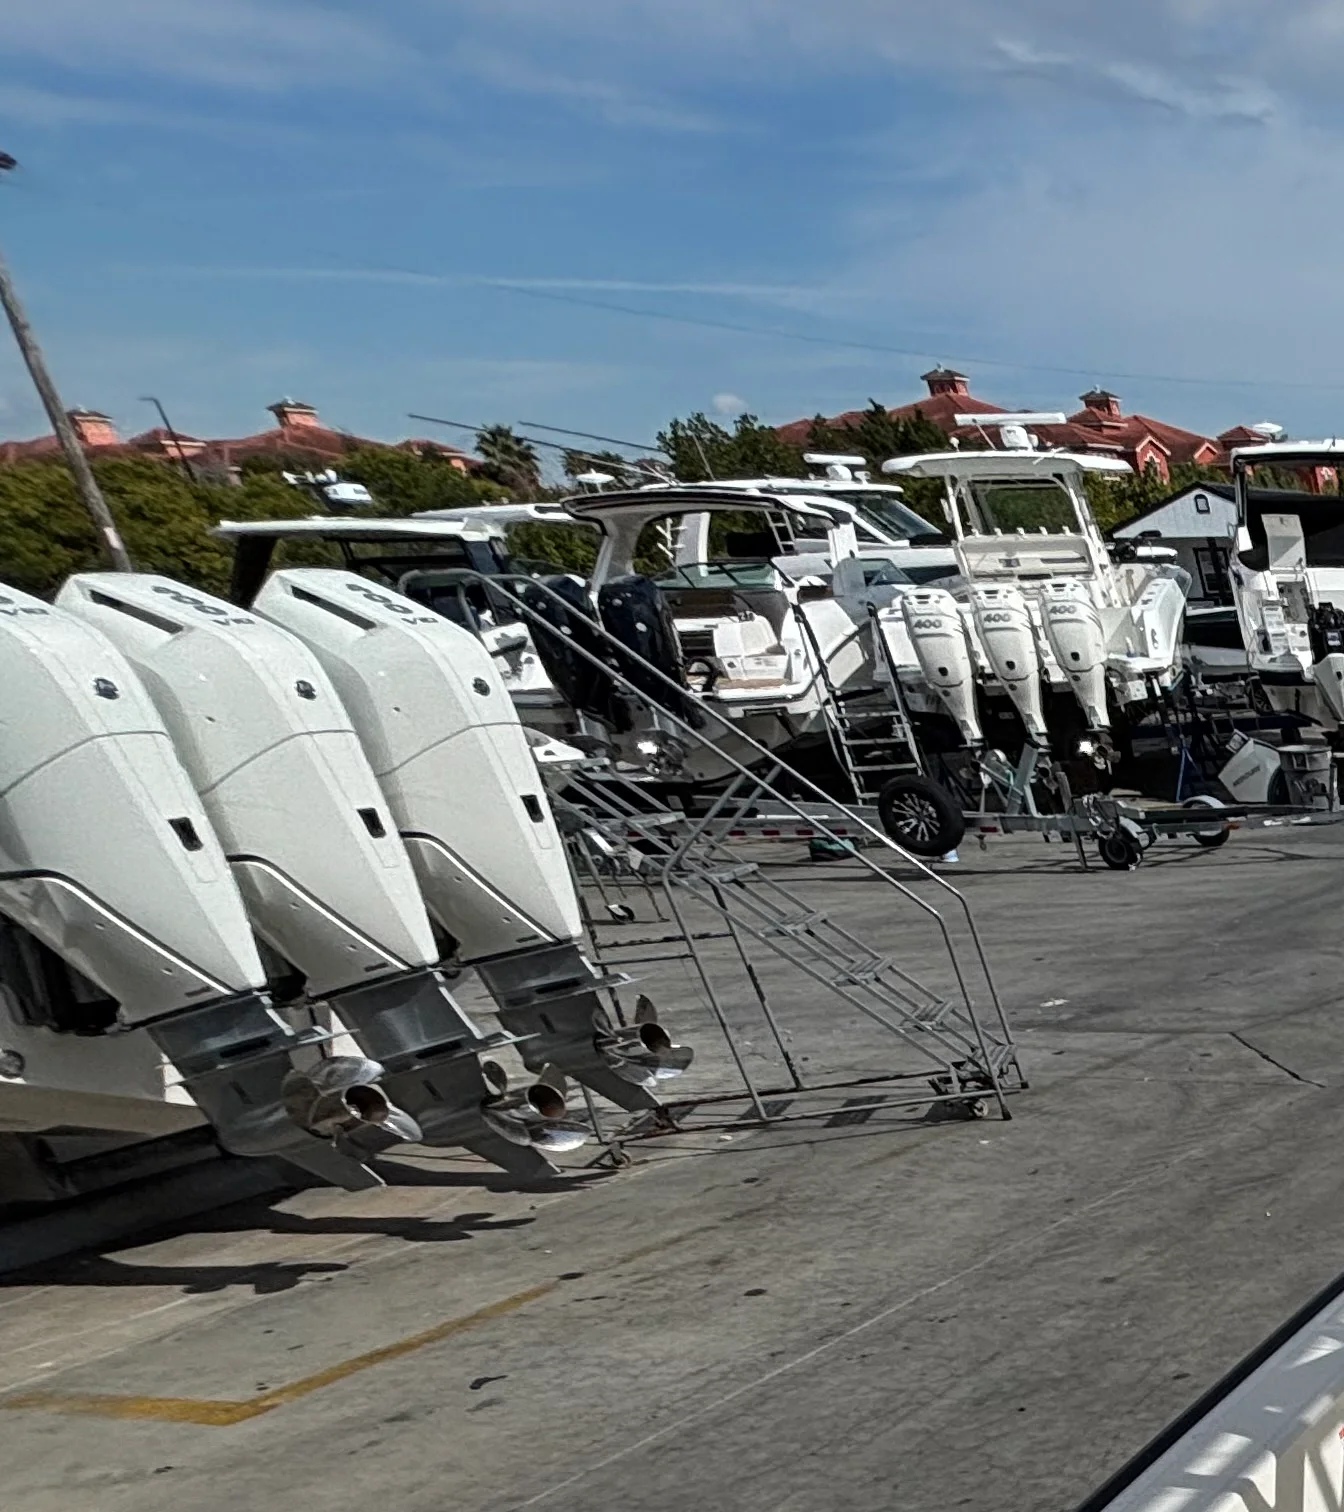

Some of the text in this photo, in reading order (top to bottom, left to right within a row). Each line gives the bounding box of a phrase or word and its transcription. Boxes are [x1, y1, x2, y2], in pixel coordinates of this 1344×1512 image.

[1050, 605, 1077, 615] 400
[983, 613, 1012, 623] 400
[913, 618, 943, 629] 400
